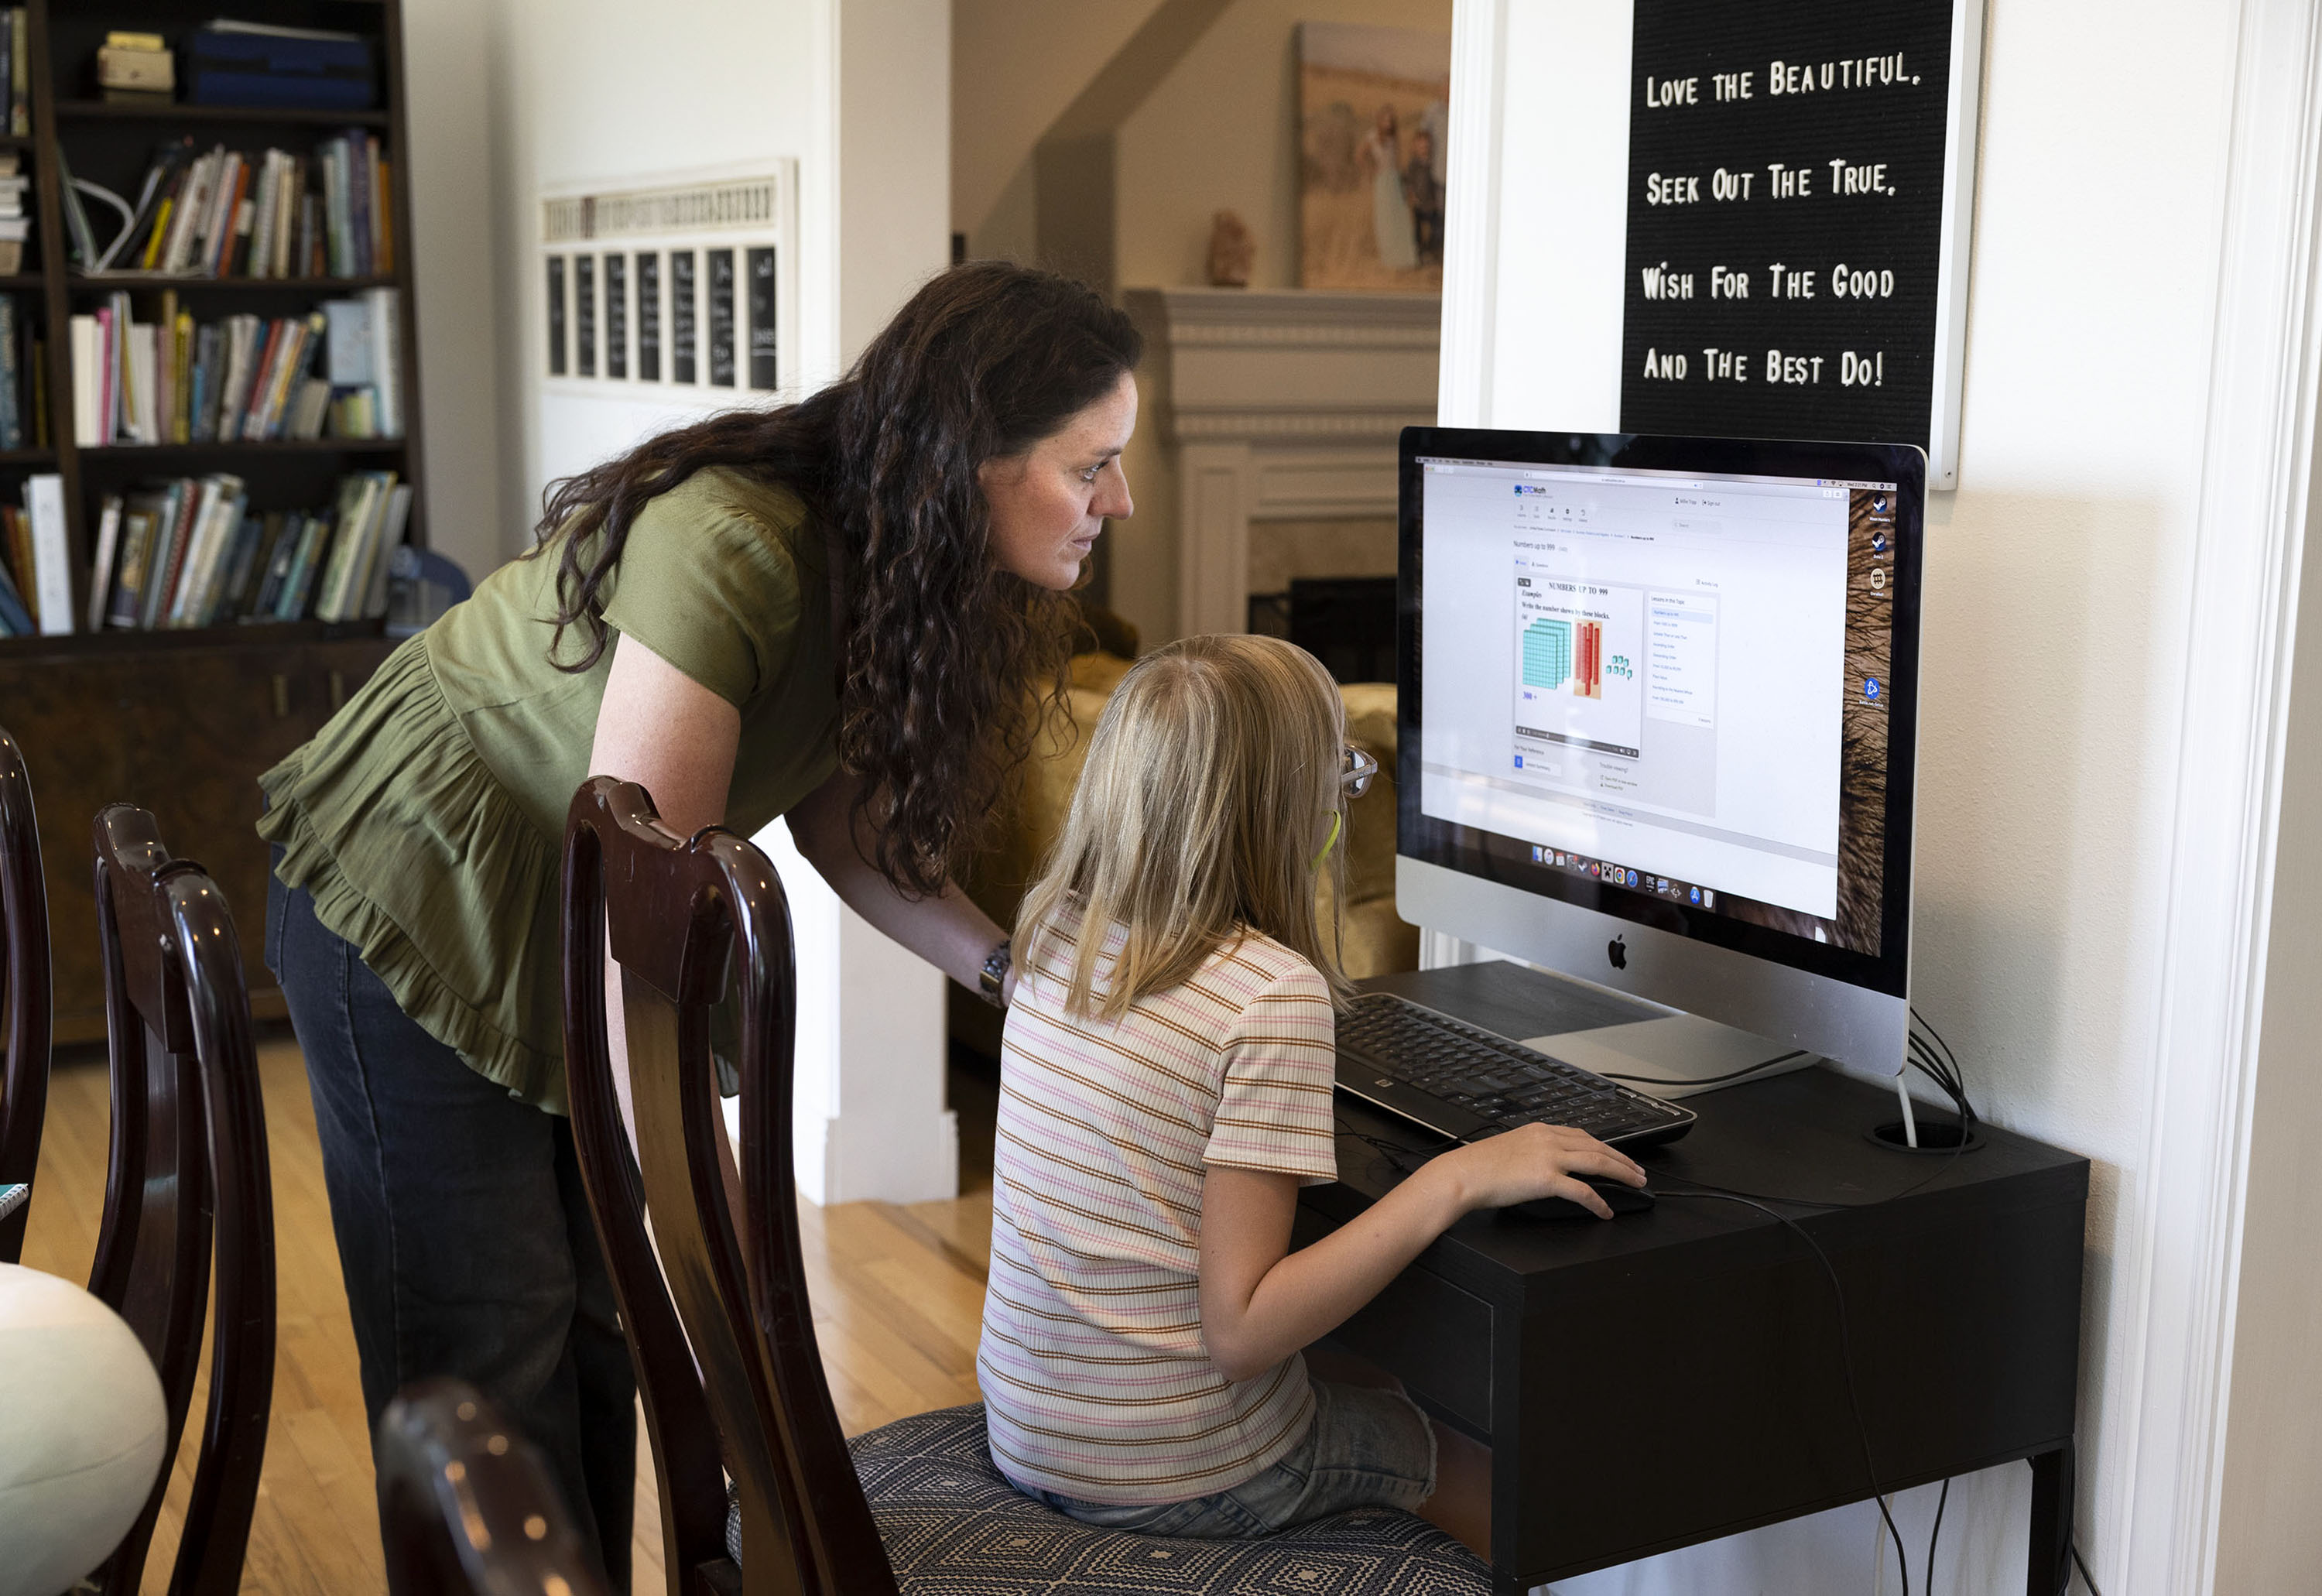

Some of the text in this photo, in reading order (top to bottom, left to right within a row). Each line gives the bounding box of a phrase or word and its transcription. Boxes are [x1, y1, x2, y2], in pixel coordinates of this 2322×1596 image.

[1646, 76, 1699, 108] LOVE
[1711, 71, 1754, 103] THE
[1646, 172, 1700, 207] SEEK
[1711, 167, 1755, 202] OUT
[1767, 163, 1812, 200] THE
[1711, 265, 1749, 300] FOR
[1769, 262, 1816, 300] THE
[1832, 263, 1895, 300] GOOD
[1643, 348, 1687, 382] AND
[1702, 348, 1748, 383] THE
[1766, 349, 1824, 385] BEST
[1549, 582, 1576, 592] NUMBERS
[1543, 604, 1560, 613] number
